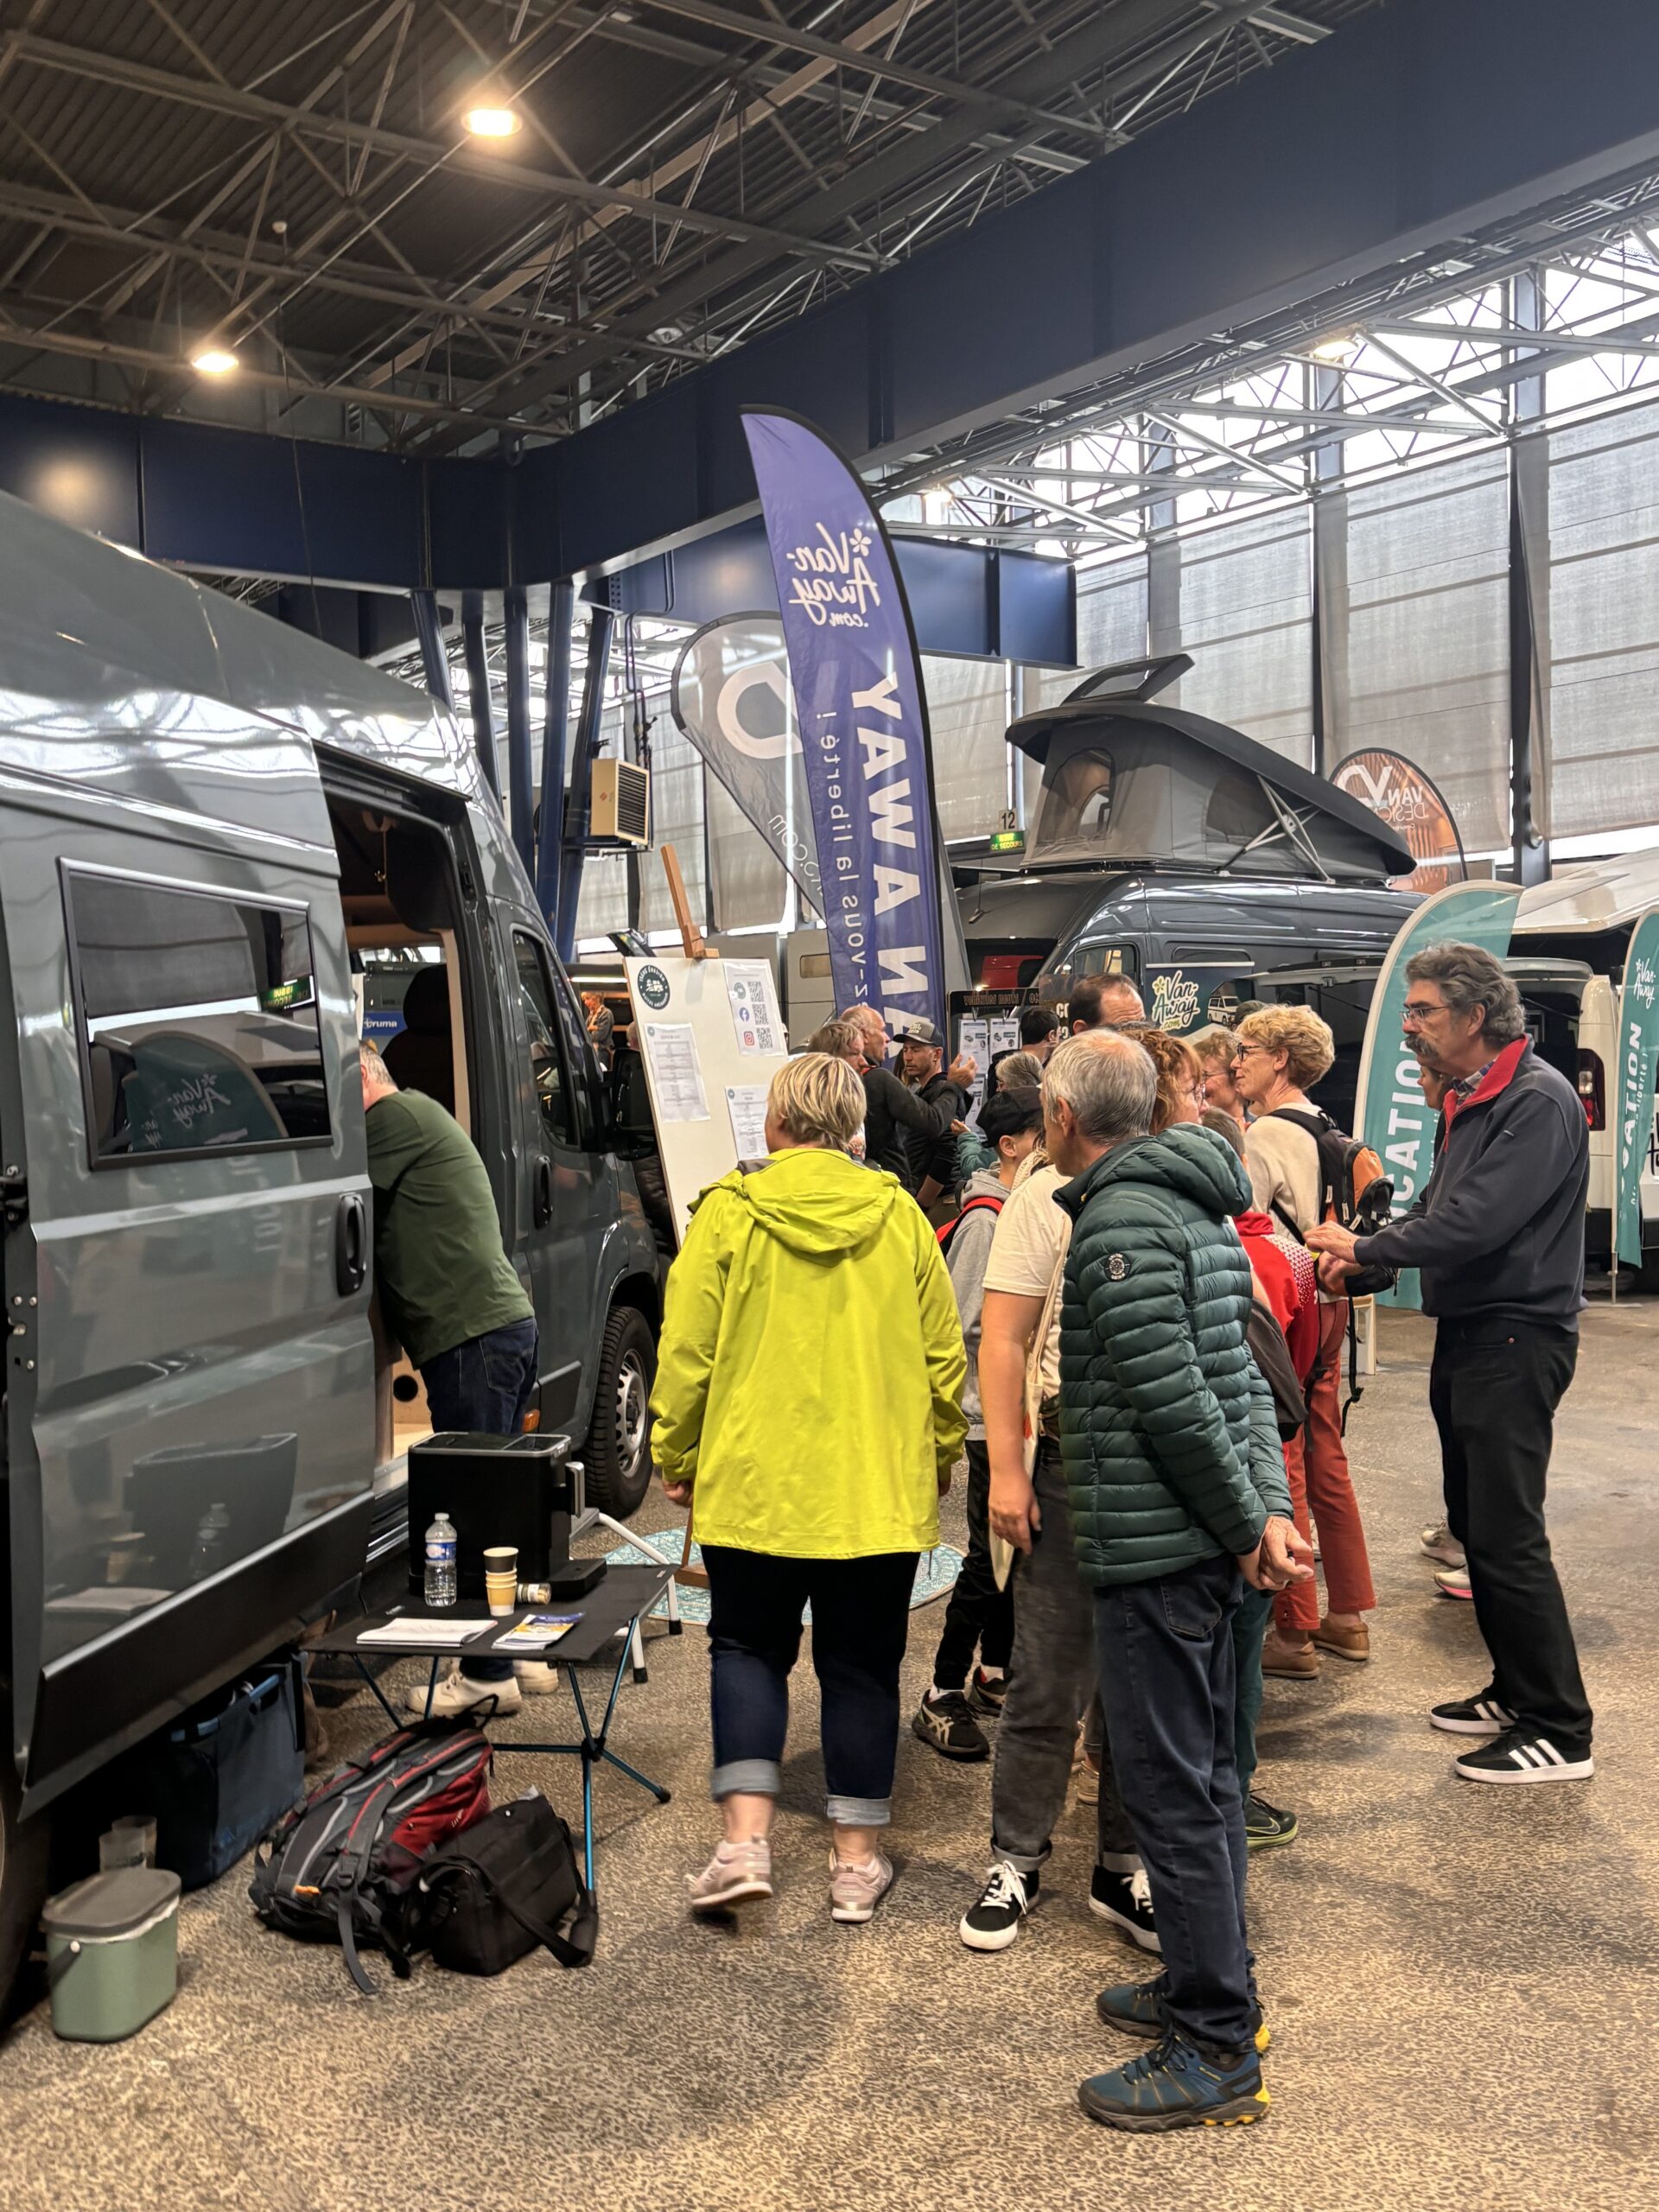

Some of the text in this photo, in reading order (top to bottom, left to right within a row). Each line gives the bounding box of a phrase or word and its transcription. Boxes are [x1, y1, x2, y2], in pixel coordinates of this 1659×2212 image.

[1001, 811, 1015, 830] 12
[1152, 994, 1200, 1027] Away
[1382, 1041, 1427, 1220] CATIO
